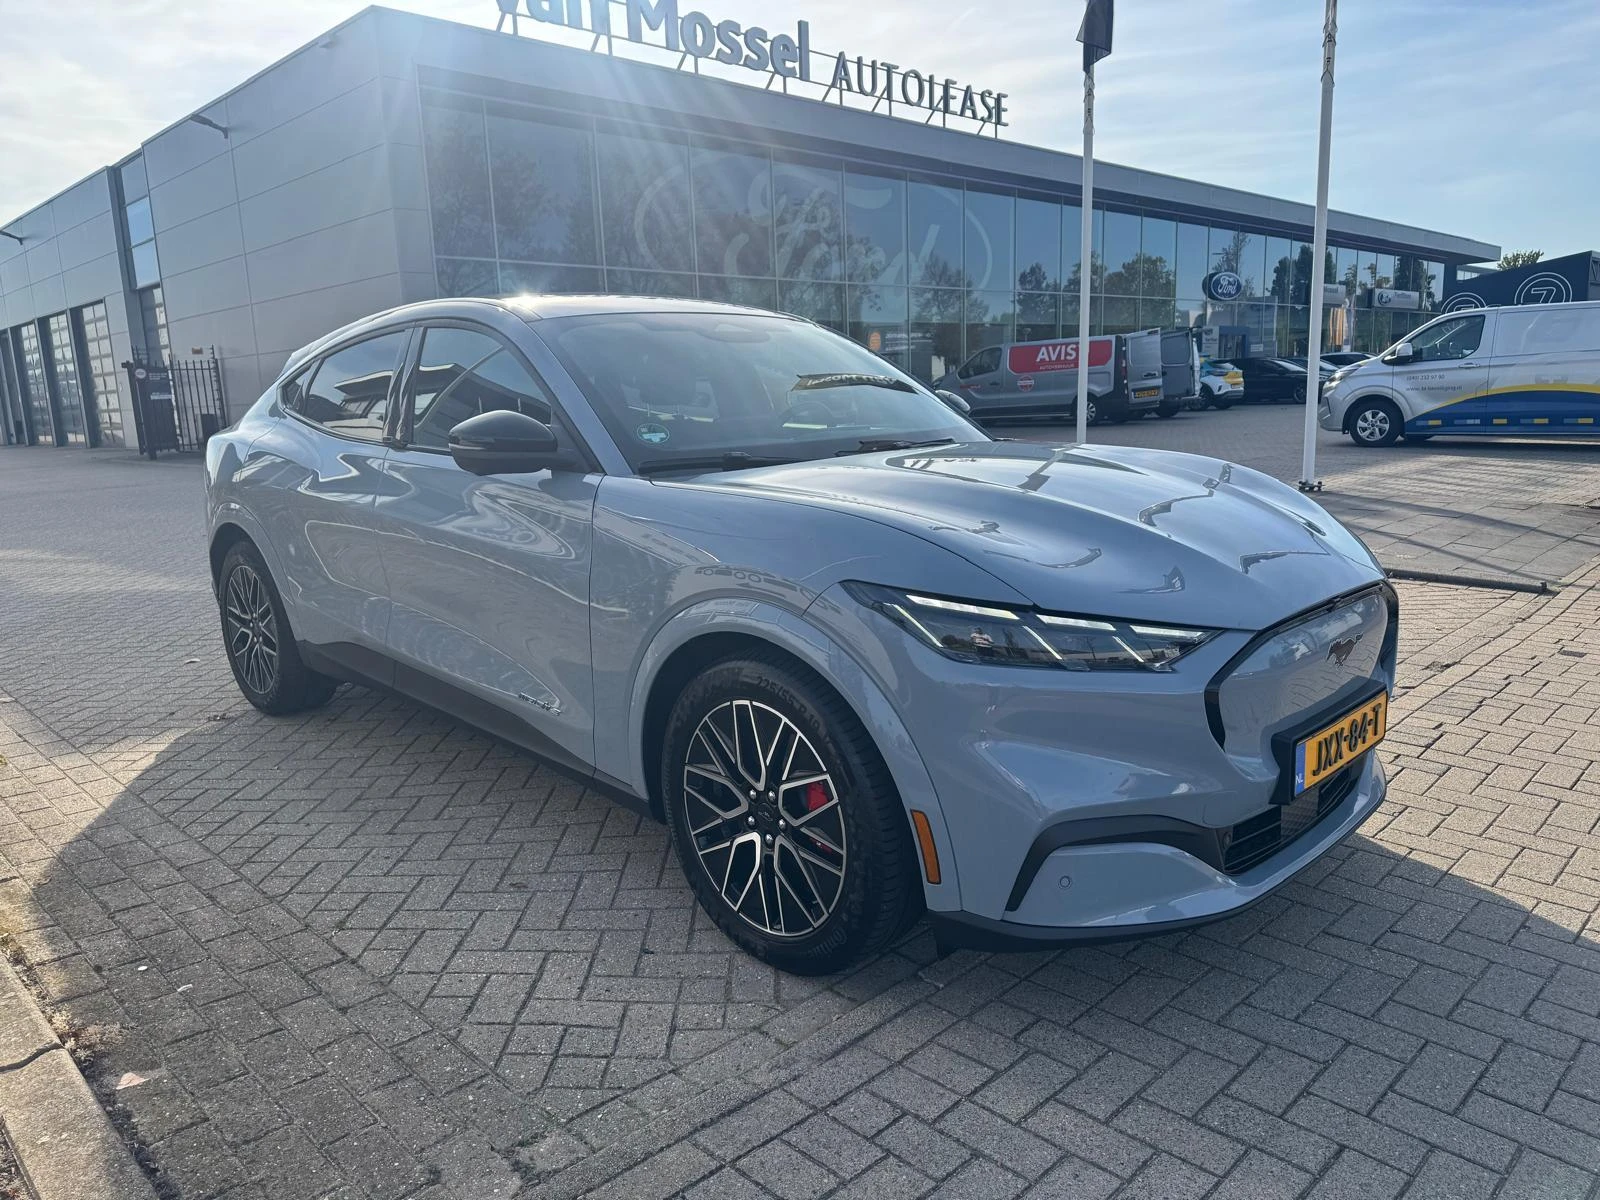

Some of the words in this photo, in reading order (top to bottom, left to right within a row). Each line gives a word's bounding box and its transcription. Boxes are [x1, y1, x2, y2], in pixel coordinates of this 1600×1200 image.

[626, 0, 810, 81] Mossel
[831, 50, 1009, 126] AUTOLEASE
[1217, 275, 1238, 294] Ford
[1036, 344, 1077, 362] AVIS
[1312, 703, 1381, 776] JXX-84-T
